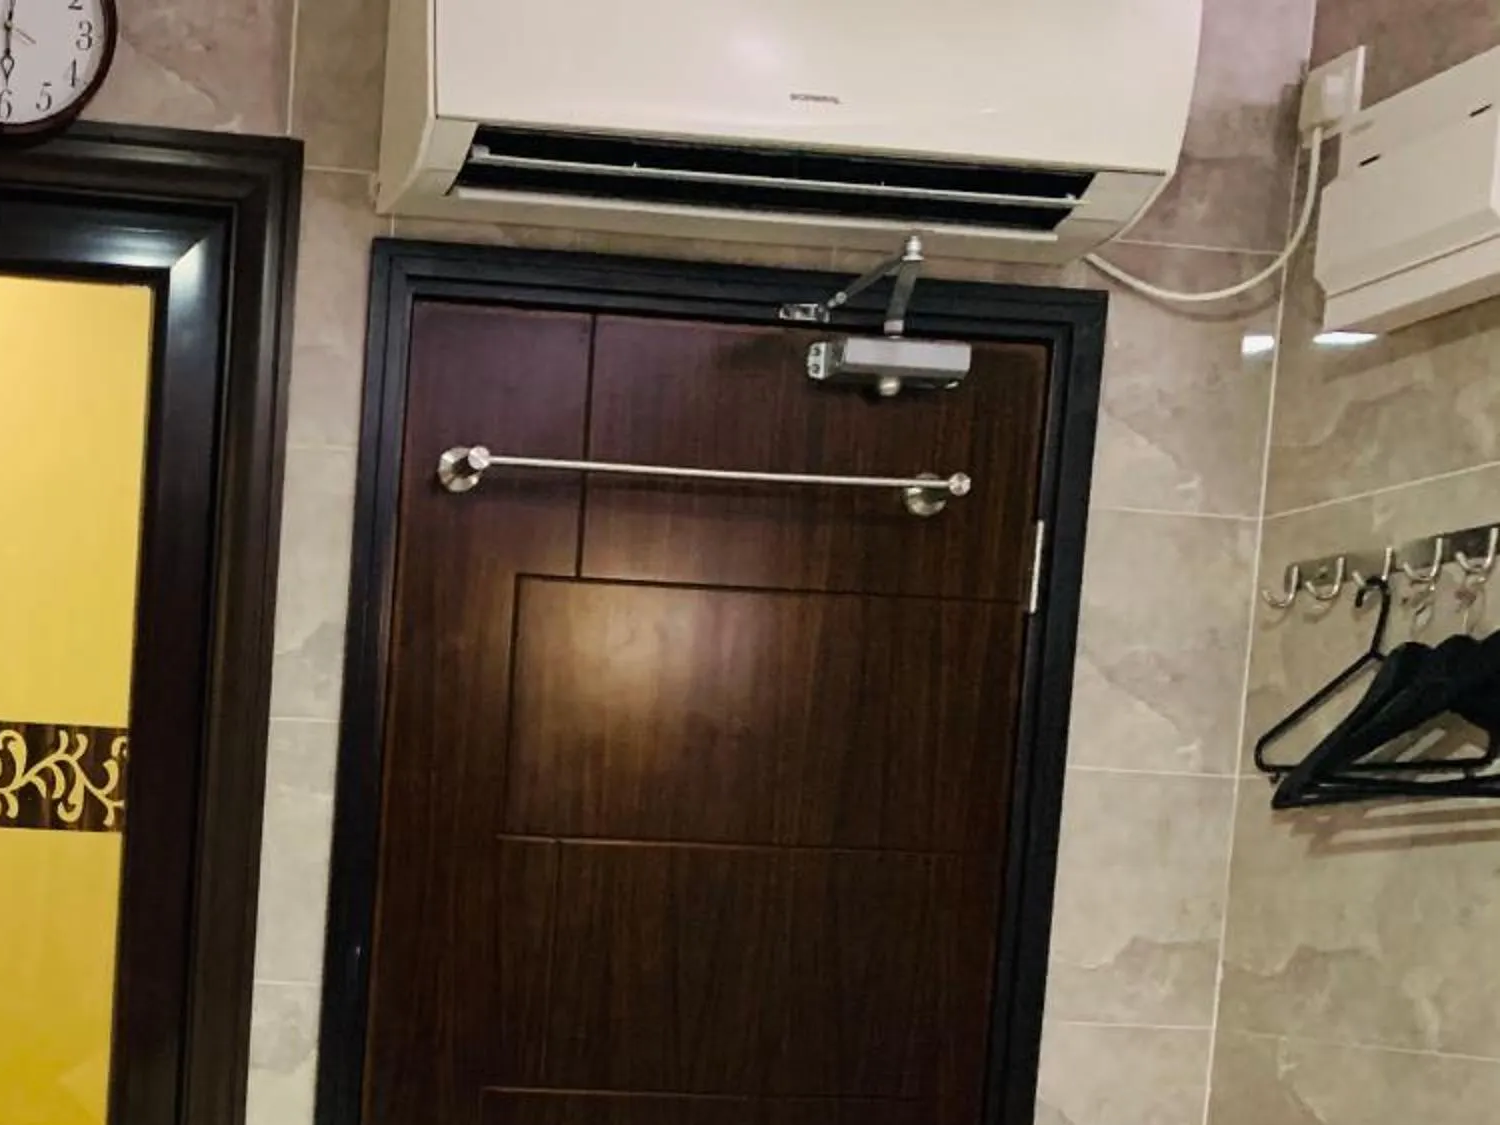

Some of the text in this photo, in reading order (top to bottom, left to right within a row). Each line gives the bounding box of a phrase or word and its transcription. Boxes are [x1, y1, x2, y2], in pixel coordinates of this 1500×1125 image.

[76, 21, 93, 50] 3
[66, 59, 80, 88] 4
[36, 82, 52, 111] 5
